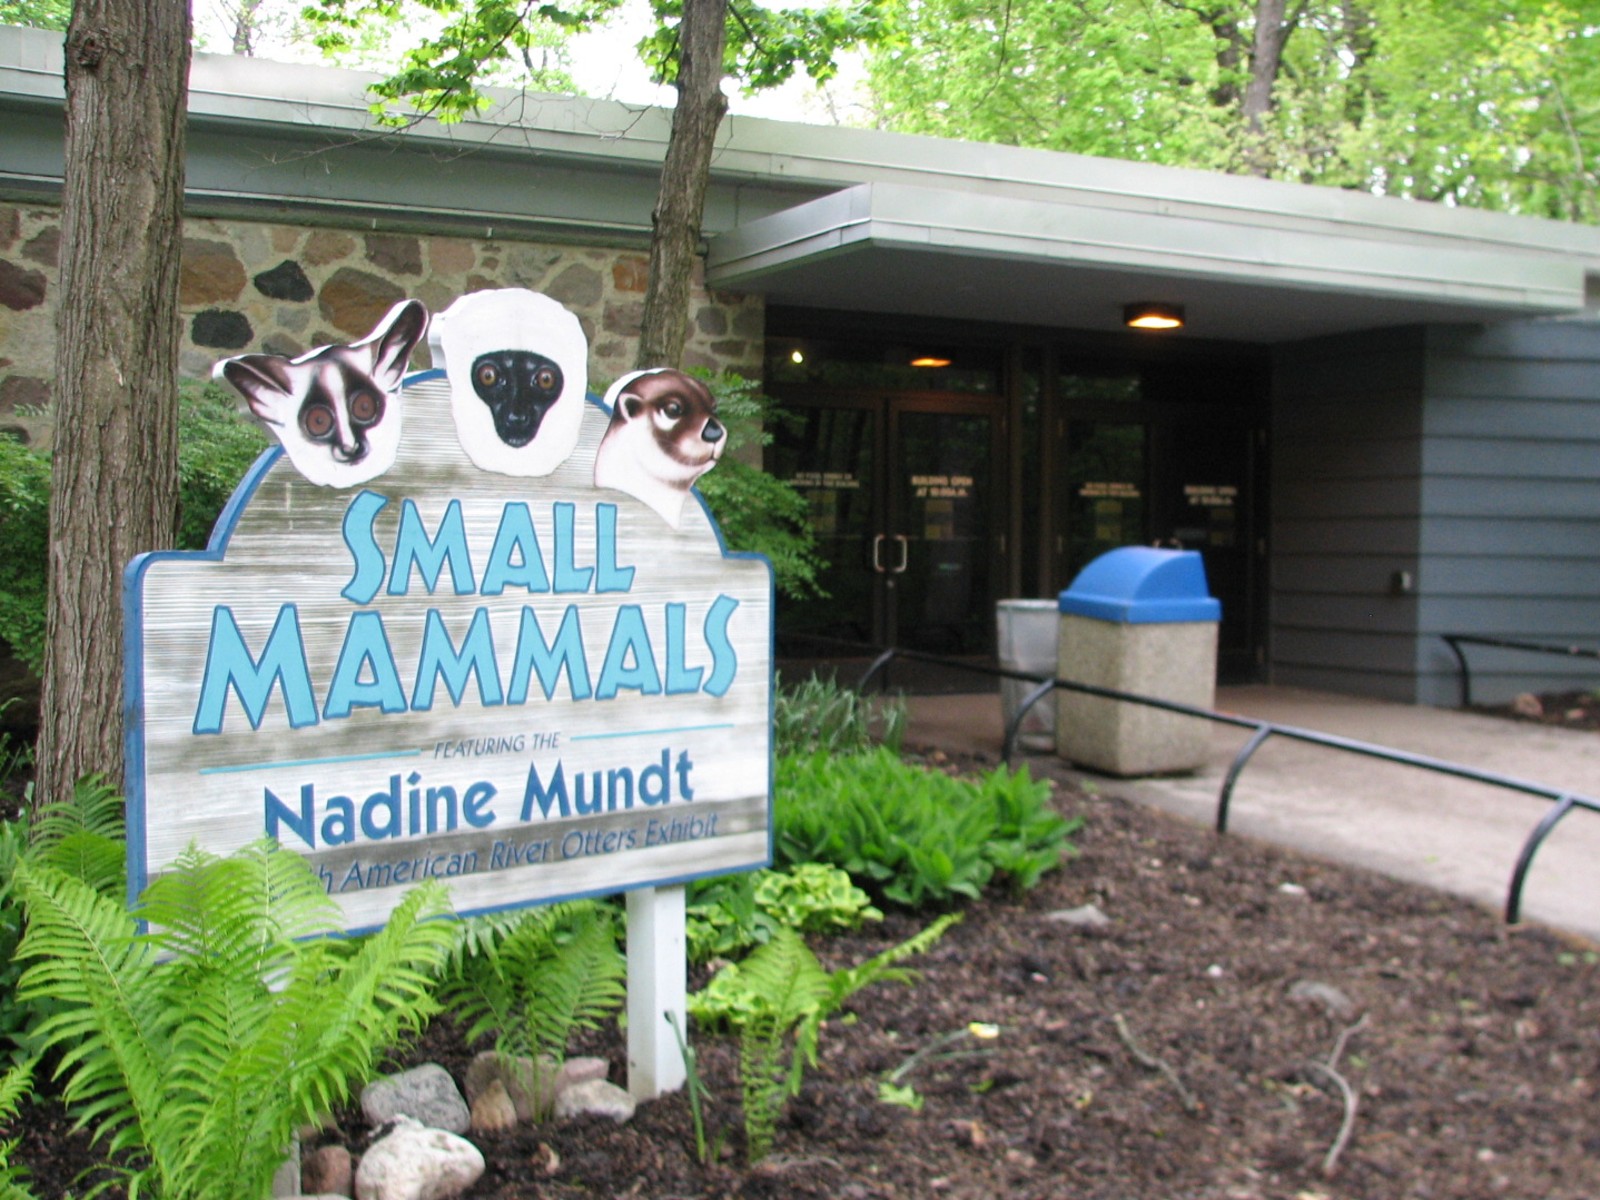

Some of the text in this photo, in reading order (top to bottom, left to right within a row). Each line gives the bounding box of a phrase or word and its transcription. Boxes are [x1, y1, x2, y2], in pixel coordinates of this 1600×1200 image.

[341, 489, 636, 605] SMALL
[192, 594, 740, 735] MAMMALS
[434, 732, 561, 760] FEATURING THE
[264, 748, 695, 850] Nadine Mundt
[340, 850, 478, 892] American
[489, 836, 553, 866] River
[562, 827, 637, 860] Otters
[644, 812, 719, 847] Exhibit
